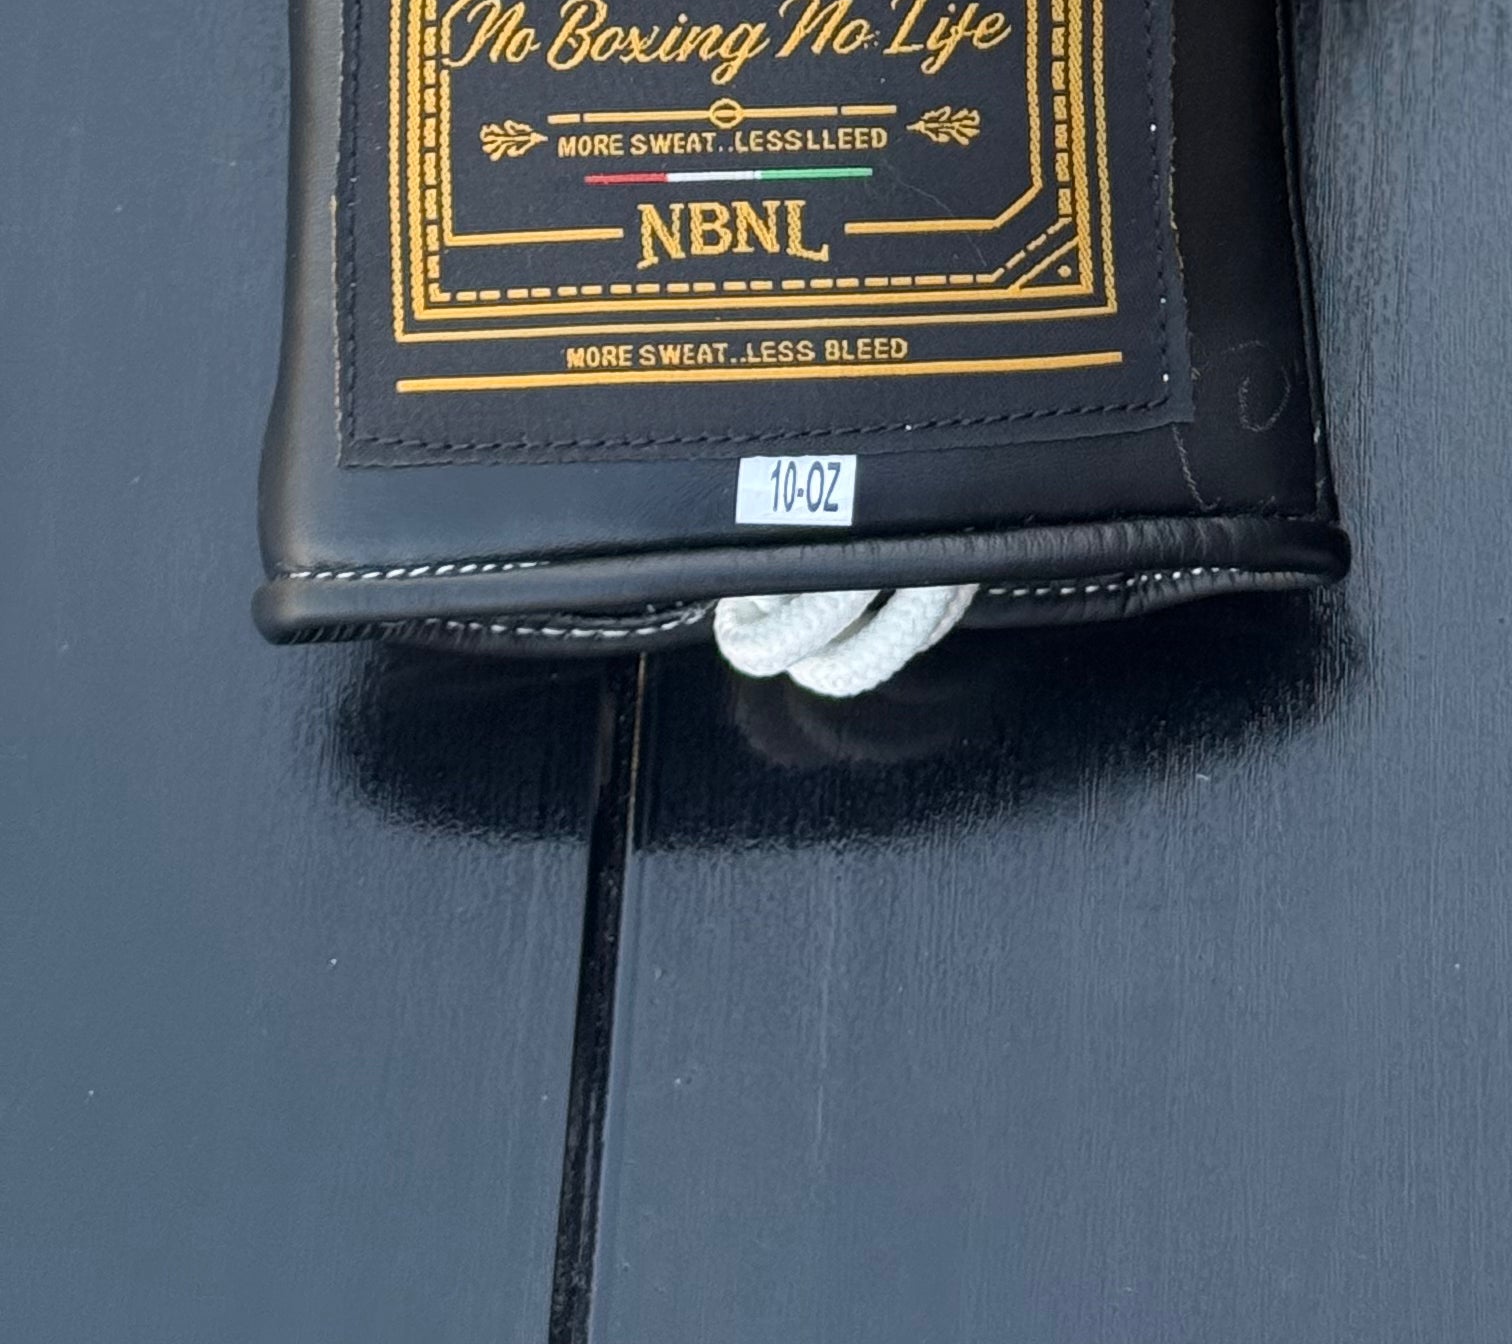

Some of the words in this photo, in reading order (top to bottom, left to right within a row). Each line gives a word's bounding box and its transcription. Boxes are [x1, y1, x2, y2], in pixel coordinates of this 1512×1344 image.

[557, 134, 625, 158] MORE
[636, 199, 830, 269] NBNL
[566, 345, 633, 368] MORE
[824, 337, 909, 361] BLEED
